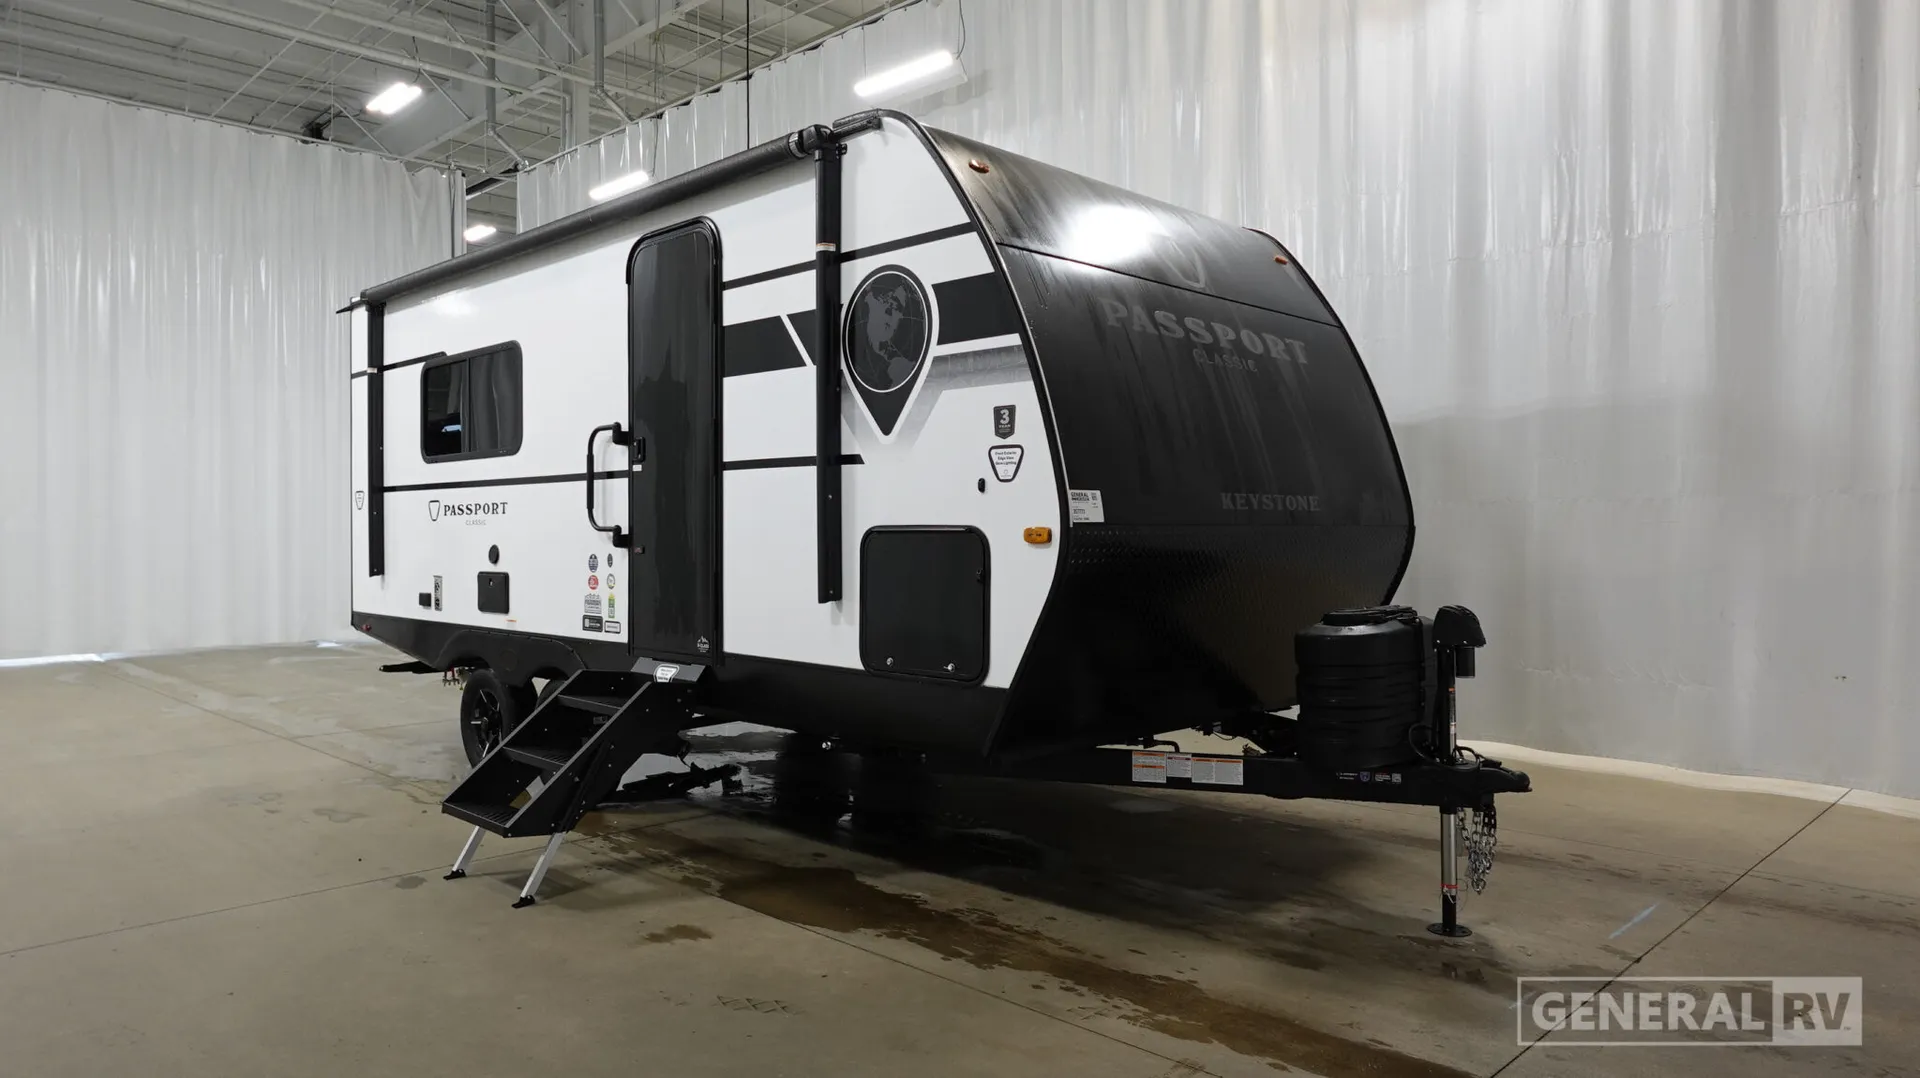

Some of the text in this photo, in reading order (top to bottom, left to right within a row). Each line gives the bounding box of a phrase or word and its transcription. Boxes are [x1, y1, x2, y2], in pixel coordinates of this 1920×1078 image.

[1101, 297, 1307, 363] PASSPORT
[1193, 348, 1259, 372] CLASSIC
[1000, 408, 1010, 424] 3
[443, 502, 509, 517] PASSPORT
[1220, 492, 1321, 511] KEYSTONE
